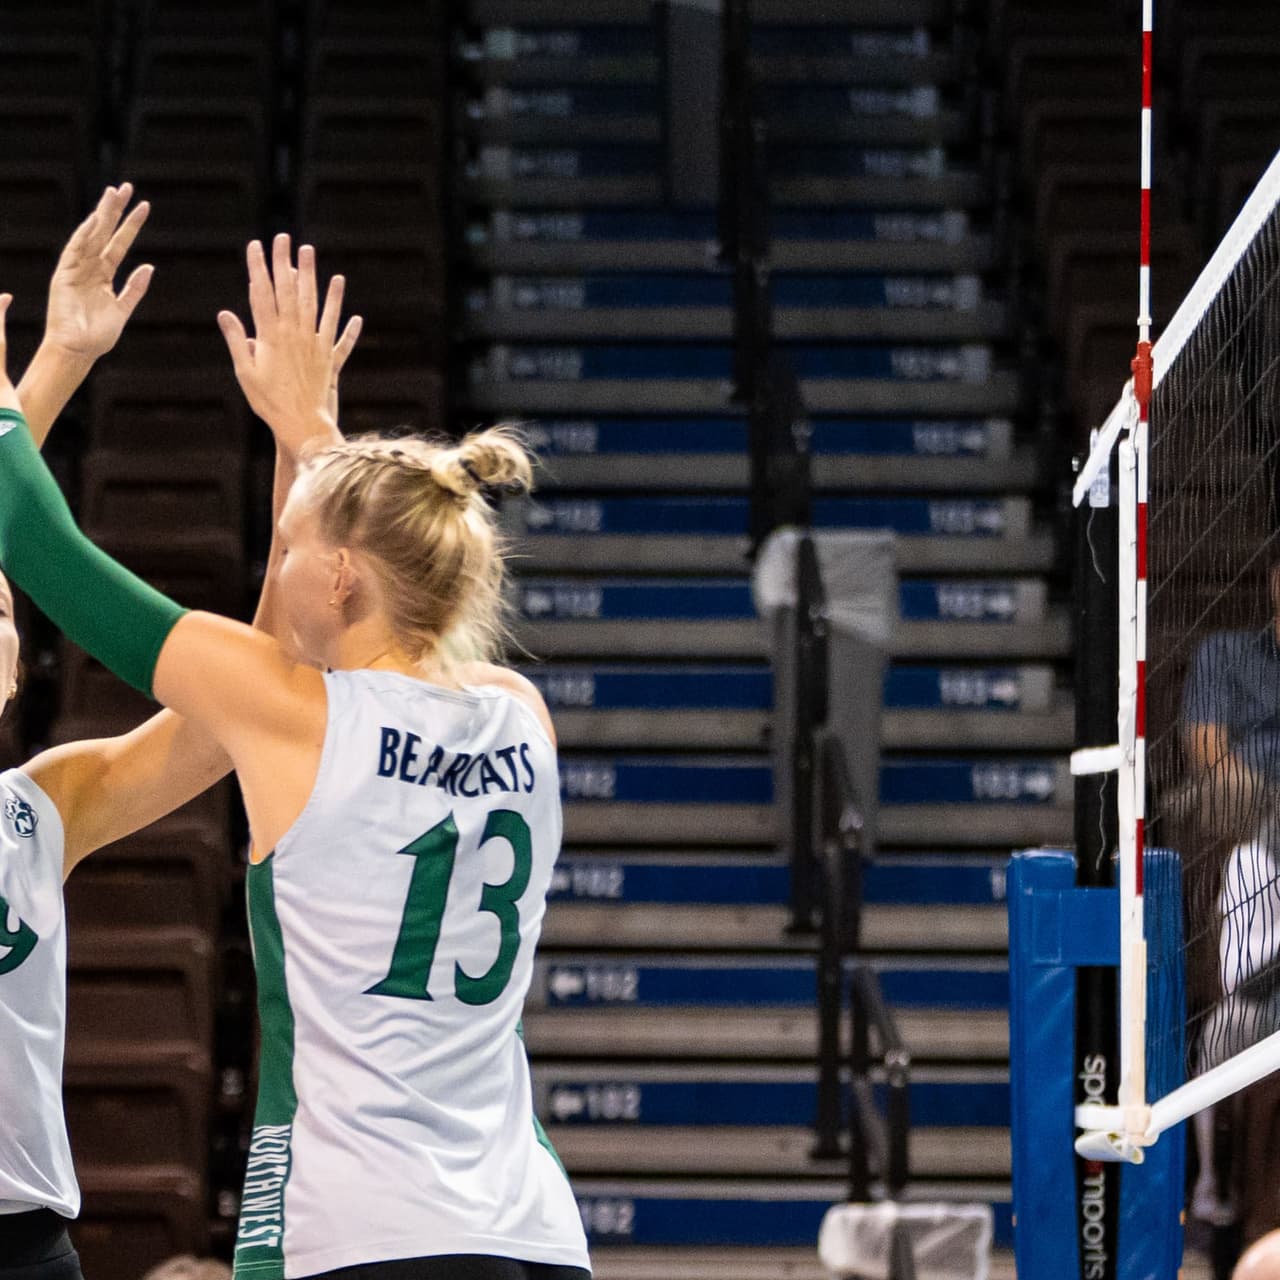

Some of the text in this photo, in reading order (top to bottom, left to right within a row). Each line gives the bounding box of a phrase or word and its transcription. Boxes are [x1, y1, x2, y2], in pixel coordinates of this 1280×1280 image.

[376, 725, 536, 798] BEARCATS
[360, 809, 534, 1006] 13
[587, 1087, 640, 1119] 102
